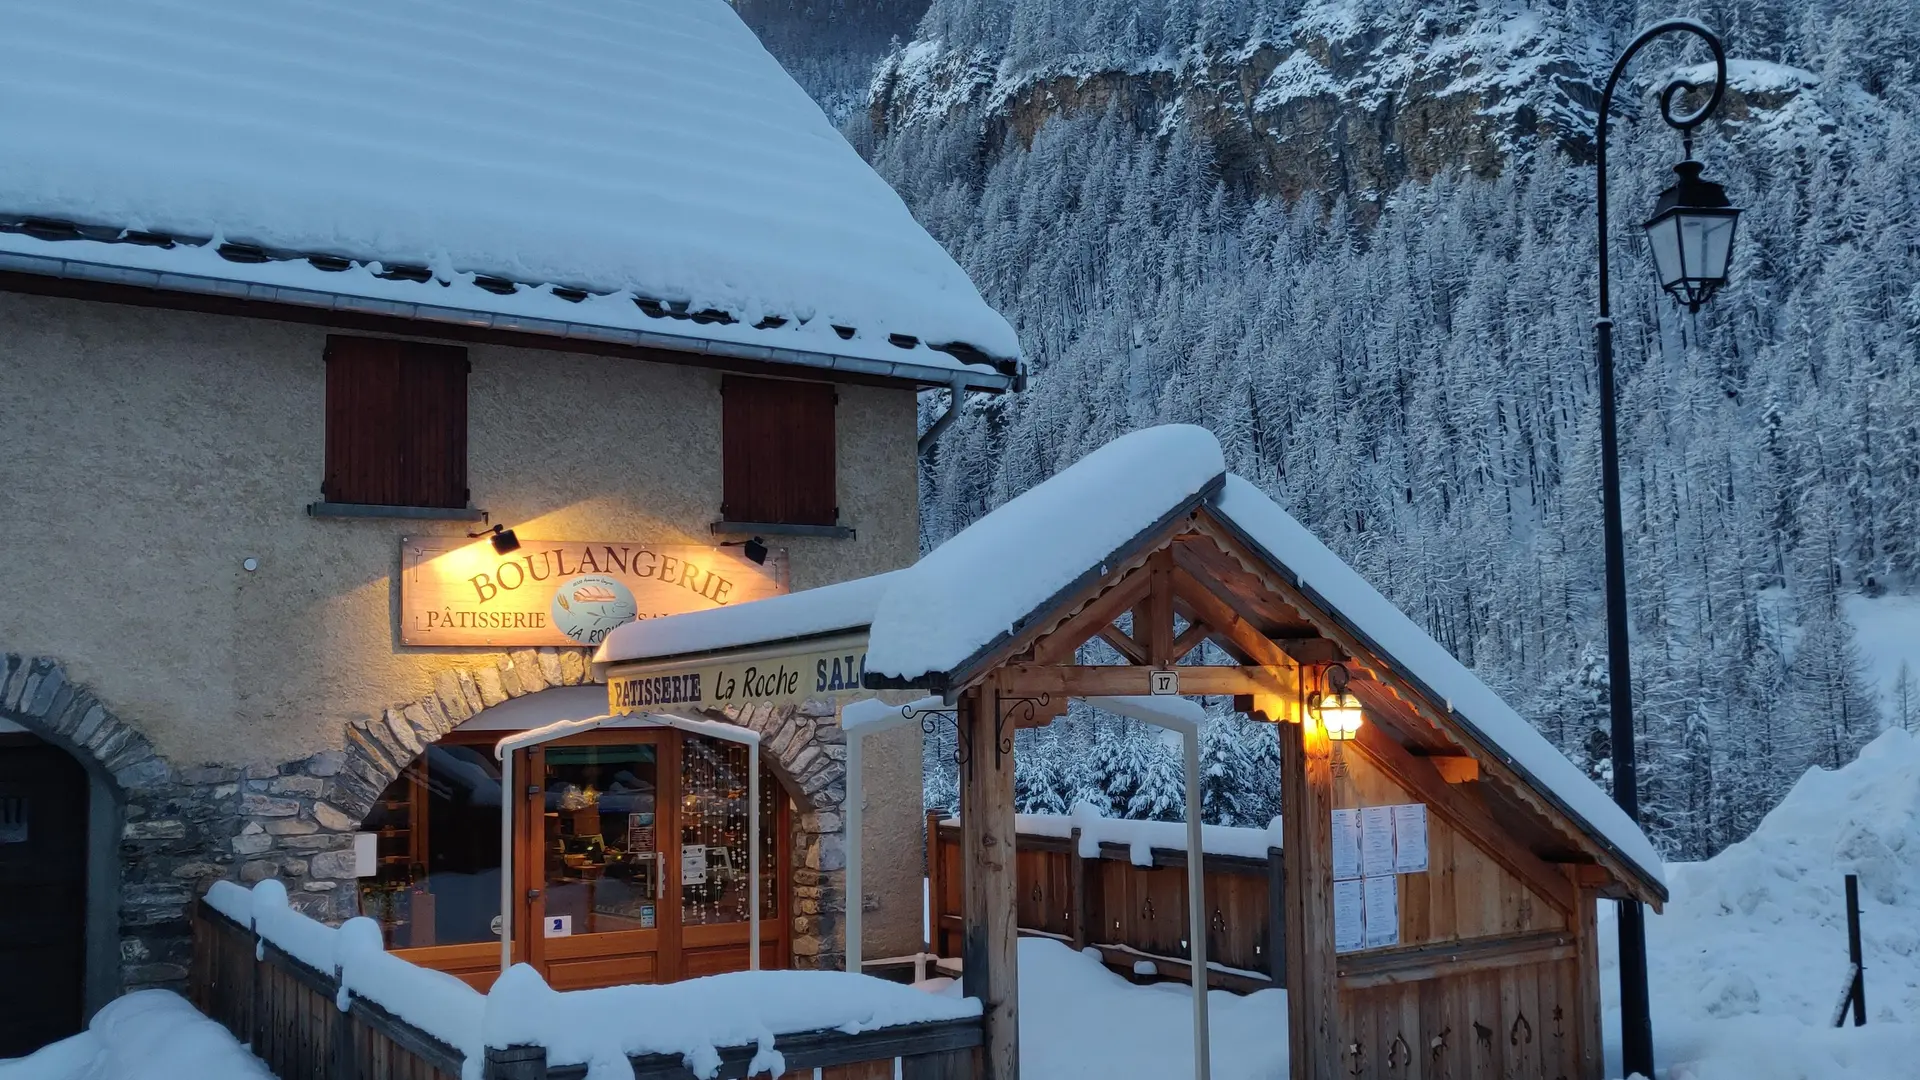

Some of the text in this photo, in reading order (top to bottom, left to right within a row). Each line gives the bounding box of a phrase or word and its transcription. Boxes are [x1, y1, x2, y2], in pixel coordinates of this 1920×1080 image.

[468, 546, 733, 605] BOULANGERIE
[426, 606, 547, 629] PÂTISSERIE
[567, 625, 583, 640] LA
[614, 673, 702, 707] PATISSERIE
[715, 670, 736, 700] La
[742, 664, 799, 698] Roche
[1158, 677, 1171, 690] 17
